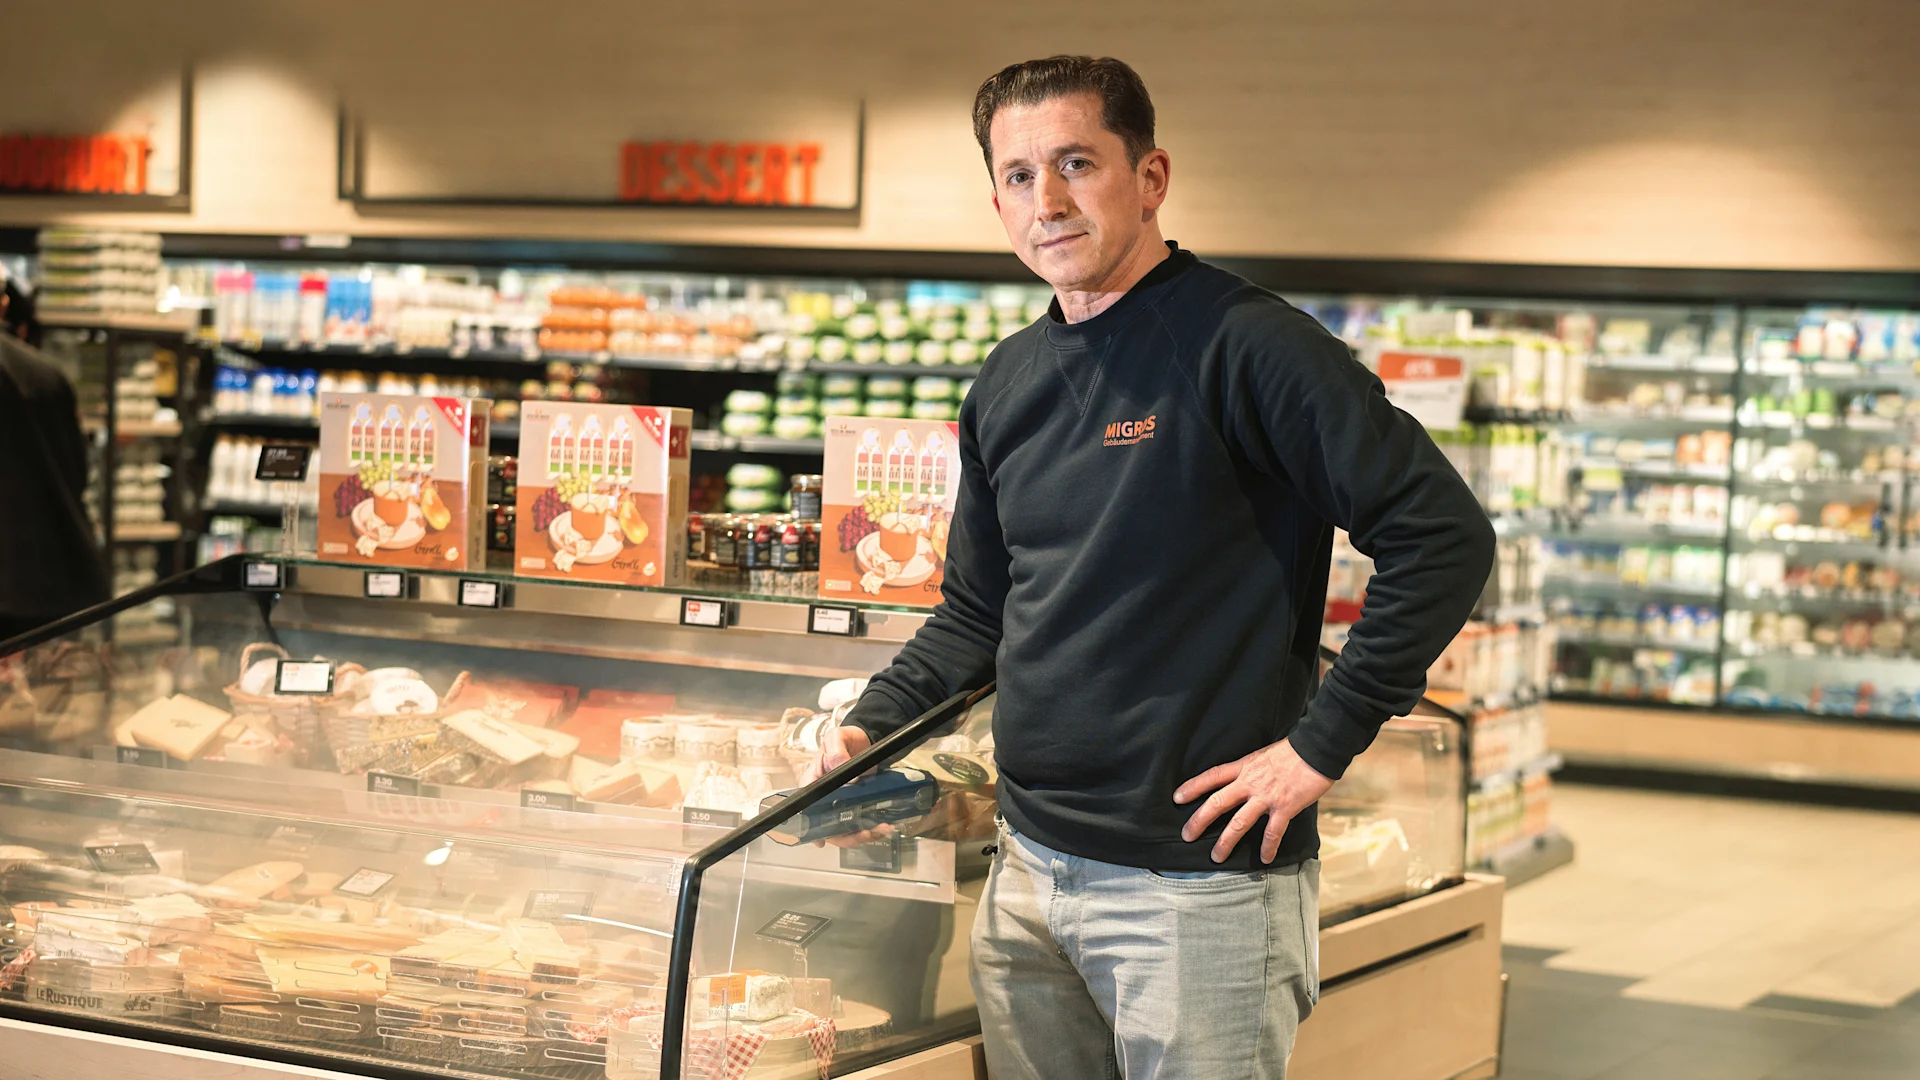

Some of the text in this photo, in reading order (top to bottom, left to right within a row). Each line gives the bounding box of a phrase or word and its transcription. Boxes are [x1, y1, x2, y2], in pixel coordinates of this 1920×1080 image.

[620, 140, 821, 206] DESSERT
[923, 580, 942, 593] Gir
[529, 794, 547, 803] 3.00
[691, 811, 710, 821] 3.50
[36, 987, 104, 1009] LE RUSTIQUE
